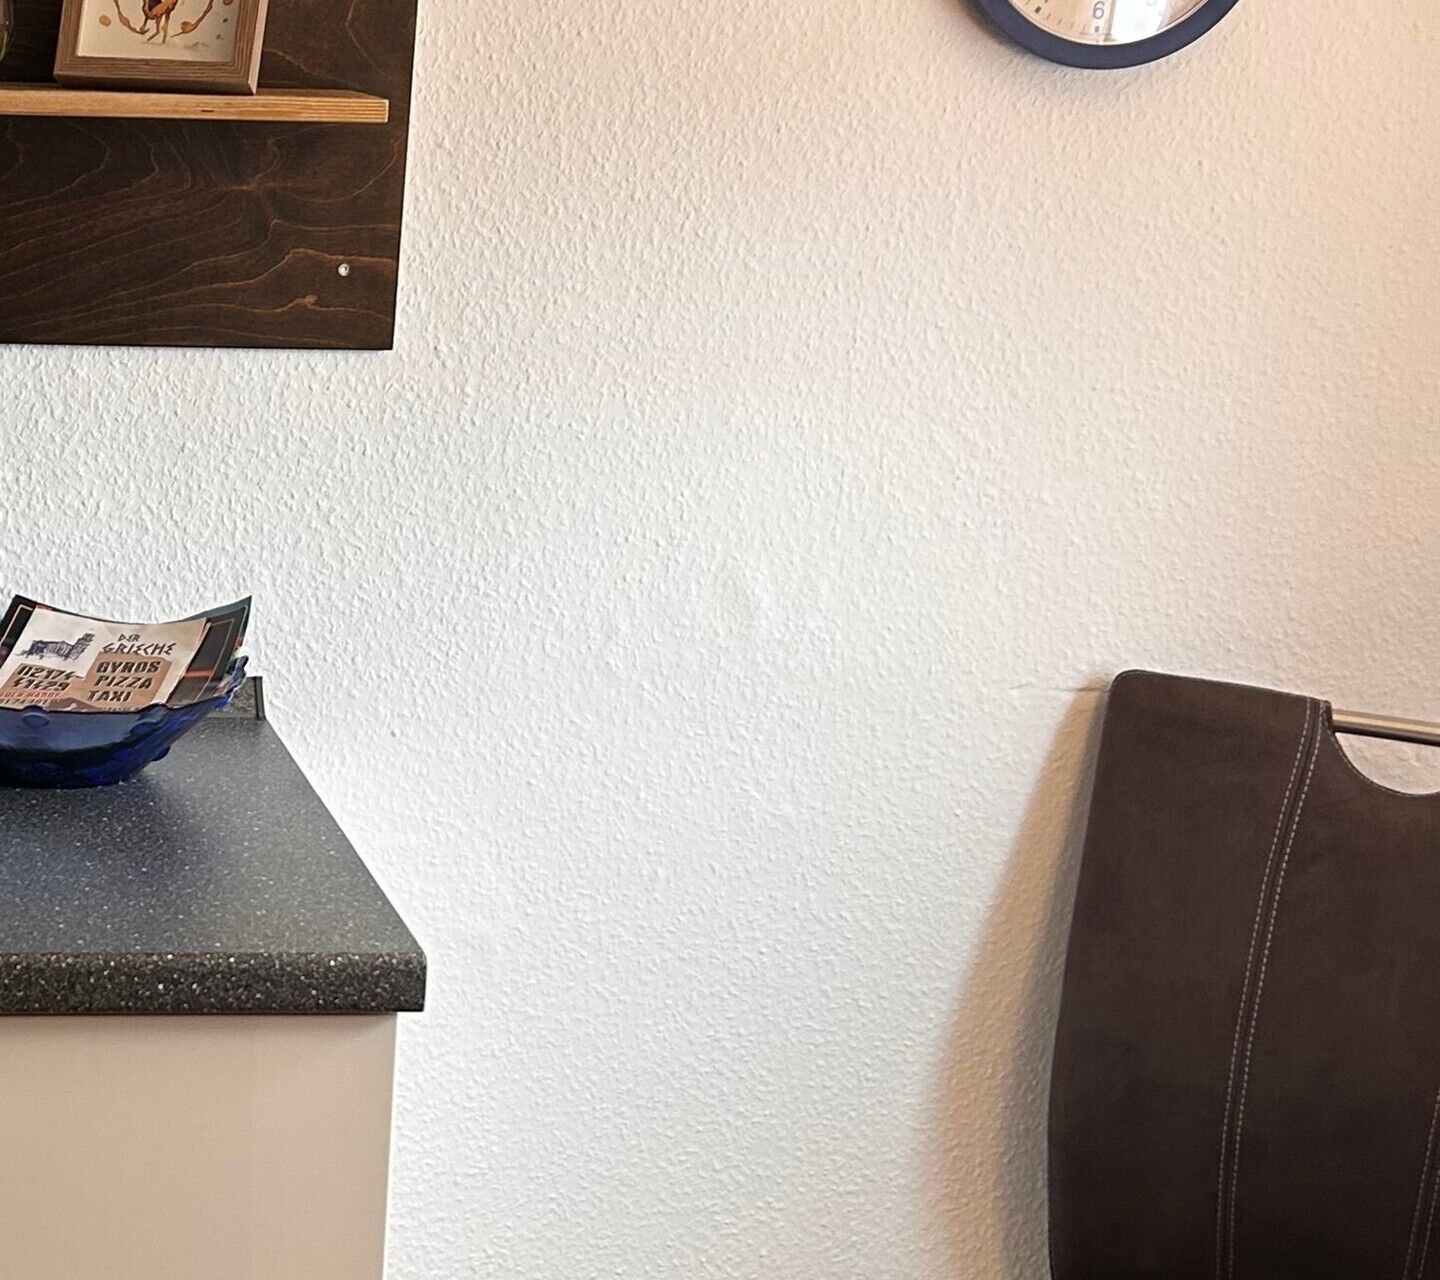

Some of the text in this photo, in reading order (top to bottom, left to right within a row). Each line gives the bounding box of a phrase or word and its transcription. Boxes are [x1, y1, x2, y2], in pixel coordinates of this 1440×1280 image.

[1092, 0, 1105, 20] 6
[96, 661, 162, 673] GYROS
[93, 675, 153, 689] PIZZA
[87, 690, 133, 702] TAXI
